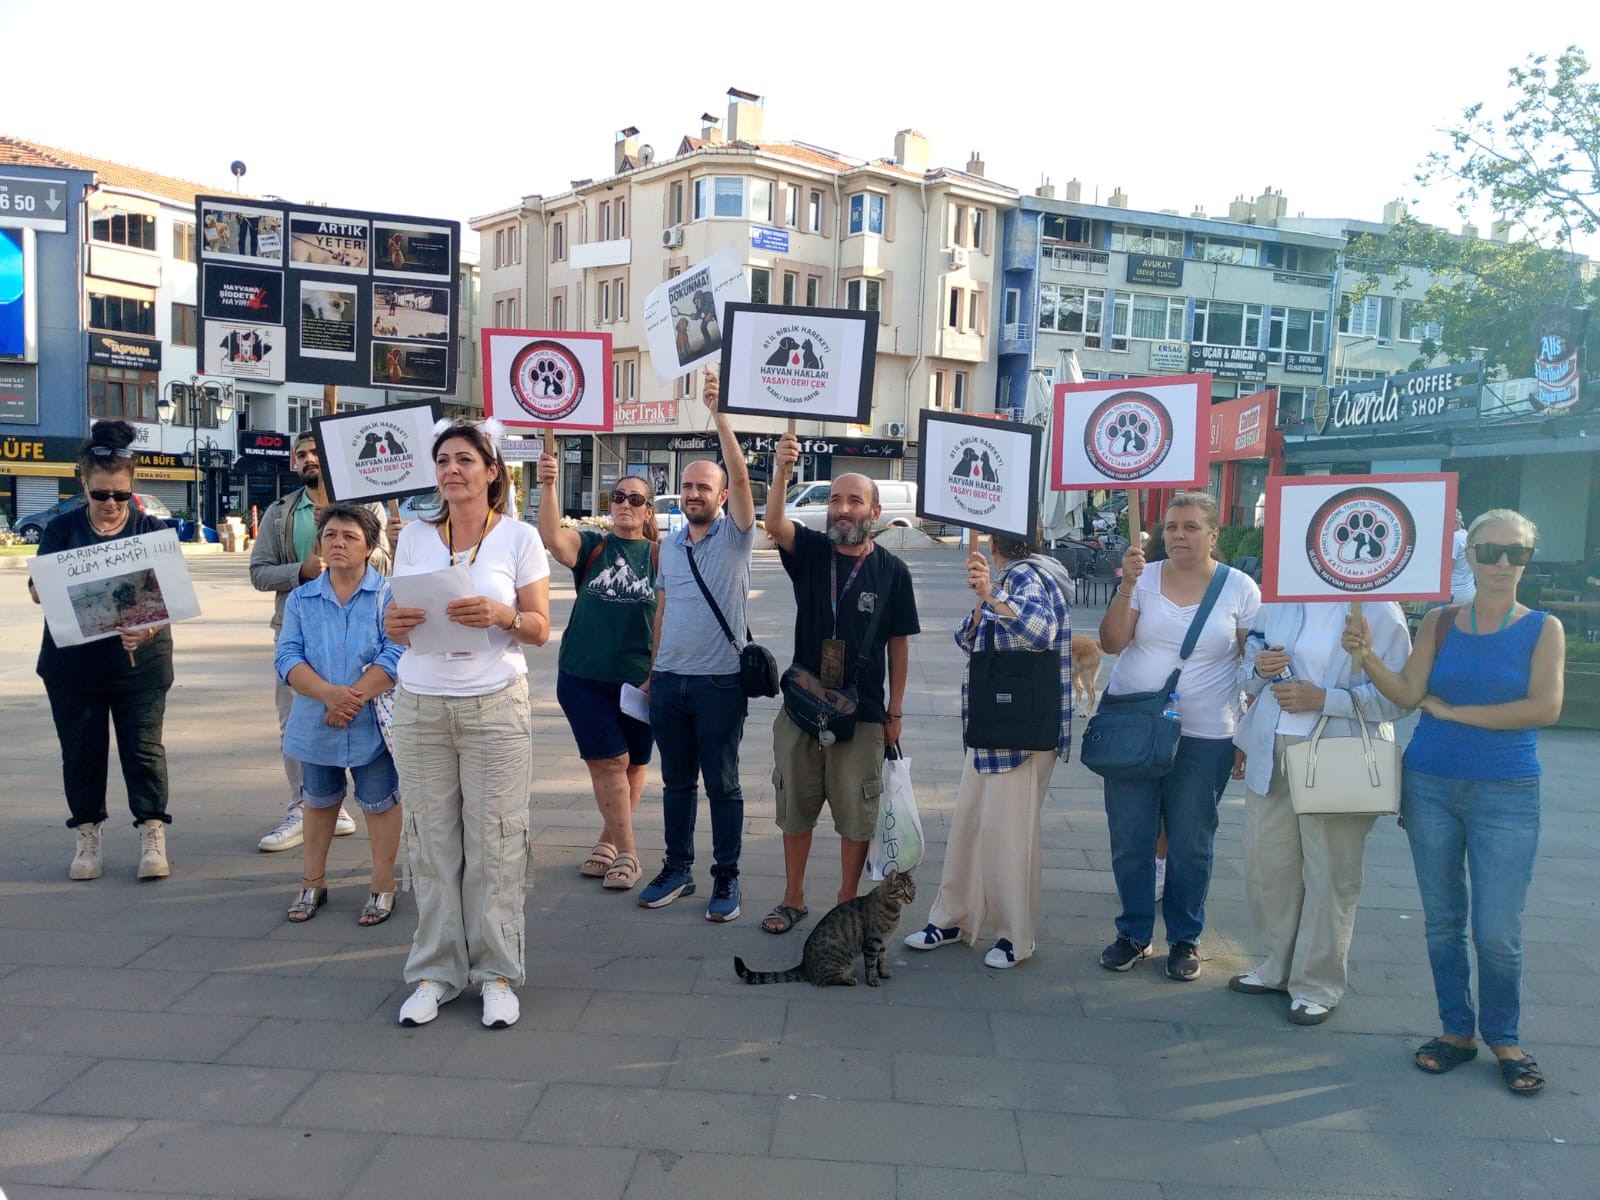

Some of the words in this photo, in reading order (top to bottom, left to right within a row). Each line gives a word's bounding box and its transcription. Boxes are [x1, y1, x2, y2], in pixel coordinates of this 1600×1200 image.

[14, 195, 35, 212] 50
[318, 222, 362, 236] ARTIK
[316, 236, 366, 250] YETER!
[1142, 260, 1172, 269] AVUKAT
[668, 274, 710, 304] DOKUNMA!
[1202, 347, 1222, 359] UÇAR
[1224, 349, 1229, 359] &
[760, 366, 792, 376] HAYVAN
[794, 369, 829, 379] HAKLARI
[762, 376, 788, 385] YASAYI
[791, 378, 808, 386] GERİ
[811, 380, 826, 390] ÇEK
[1408, 373, 1452, 395] COFFEE
[614, 403, 664, 421] aberTrak
[1334, 380, 1399, 428] Cuerda
[1411, 397, 1445, 416] SHOP
[0, 437, 45, 459] ÜFE
[675, 437, 706, 448] Kuaför
[153, 454, 176, 466] BÜFE
[355, 458, 382, 468] HAYVAN
[384, 454, 414, 463] HAKLARI
[948, 476, 974, 487] HAYVAN
[976, 481, 1003, 493] HAKLARI
[950, 485, 971, 496] YASAYI
[68, 560, 99, 577] ÖLÜM
[1328, 558, 1364, 576] KATLİAMA
[1321, 570, 1345, 588] HAYVAN
